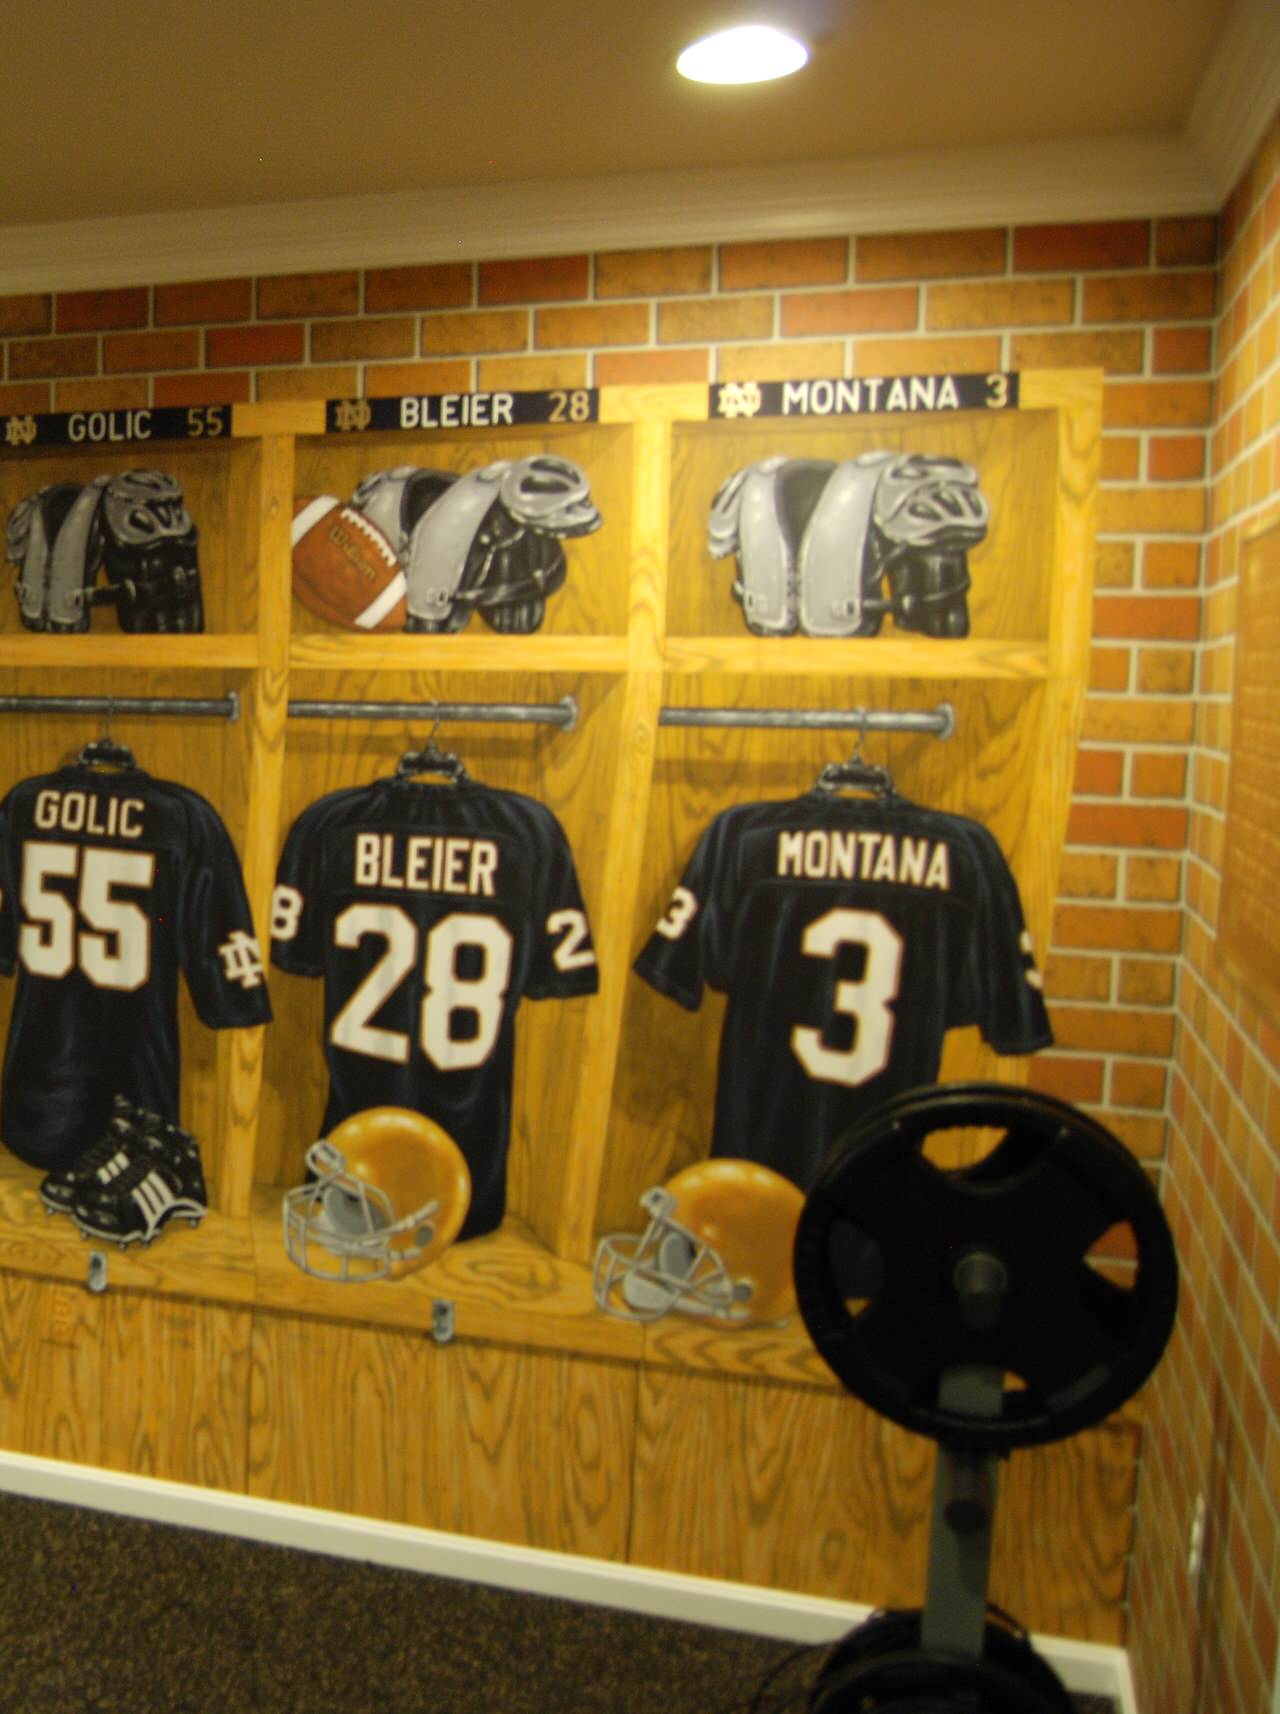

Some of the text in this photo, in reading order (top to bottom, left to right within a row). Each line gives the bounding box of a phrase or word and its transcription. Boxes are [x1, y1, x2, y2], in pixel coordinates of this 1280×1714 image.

[400, 393, 513, 429] BLEIER
[548, 390, 590, 422] 28
[781, 375, 959, 415] MONTANA
[985, 373, 1008, 409] 3
[68, 410, 151, 442] GOLIC
[187, 407, 223, 437] 55
[33, 789, 145, 838] GOLIC
[354, 832, 498, 897] BLEIER
[777, 829, 951, 891] MONTANA
[19, 839, 156, 993] 55
[270, 884, 304, 941] 8
[546, 908, 597, 973] 2
[656, 886, 699, 941] 3
[329, 901, 514, 1072] 28
[790, 906, 904, 1089] 3
